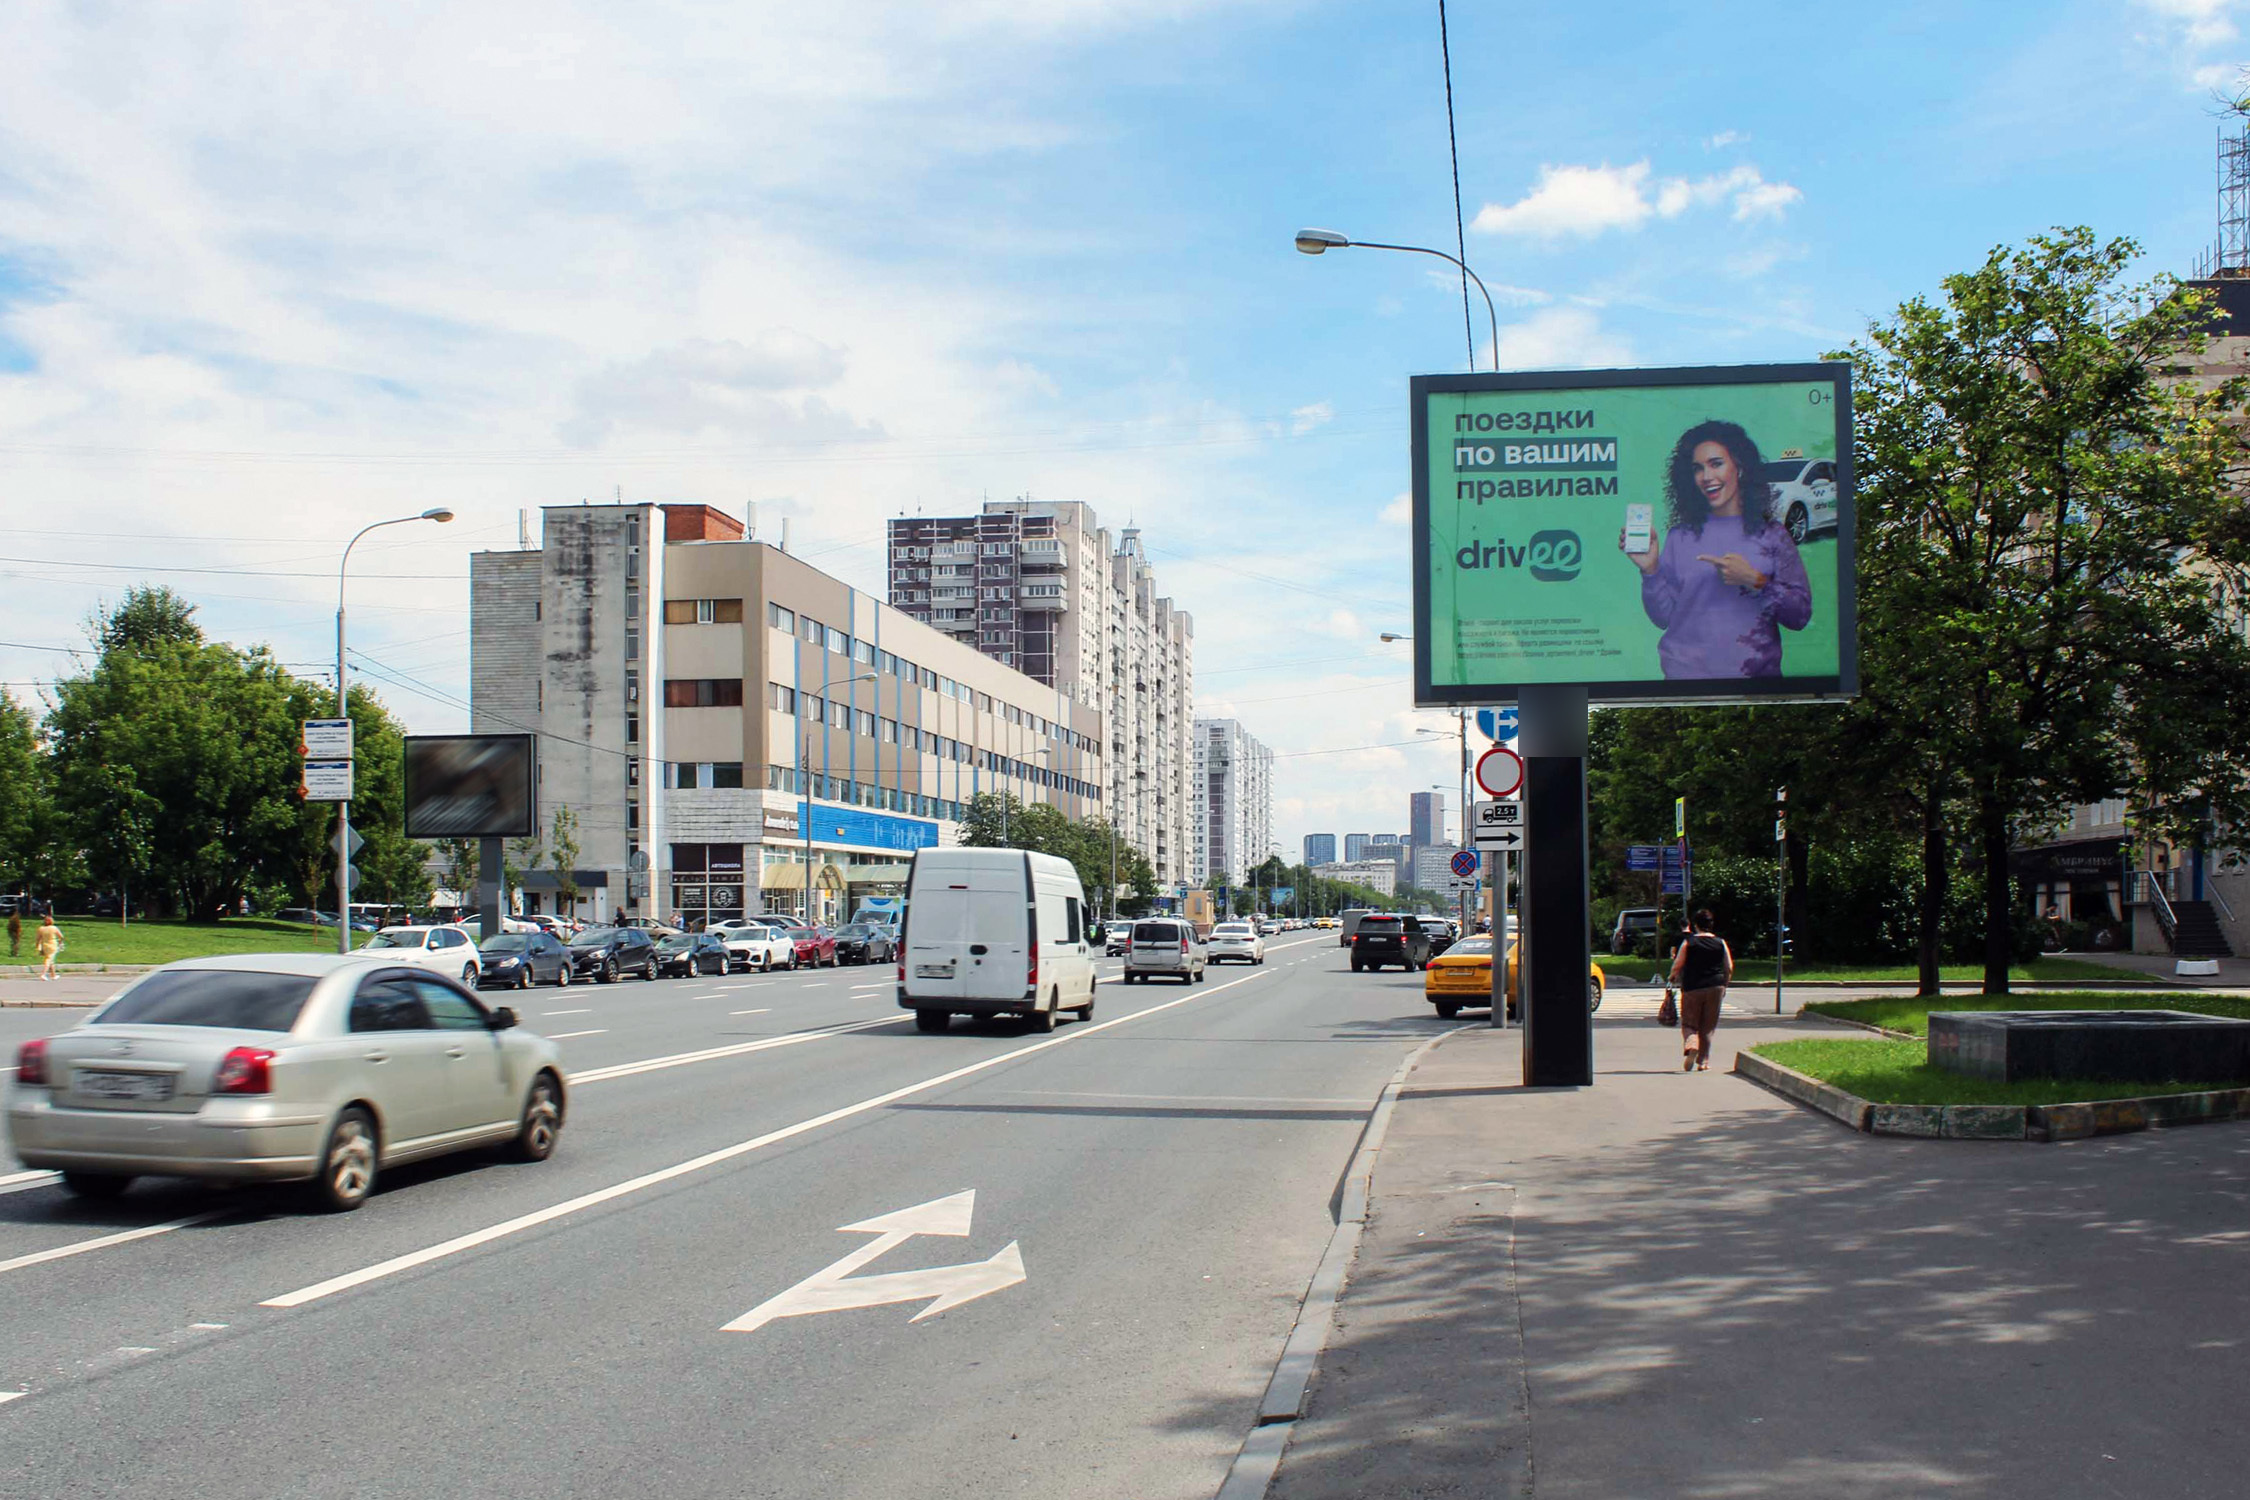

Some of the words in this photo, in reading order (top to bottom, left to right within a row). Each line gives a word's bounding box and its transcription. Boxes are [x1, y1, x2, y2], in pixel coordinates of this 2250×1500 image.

[1455, 410, 1594, 434] поездки
[1456, 446, 1495, 466] по
[1505, 441, 1616, 465] вашим
[1457, 476, 1618, 505] правилам
[1456, 537, 1582, 571] drivee
